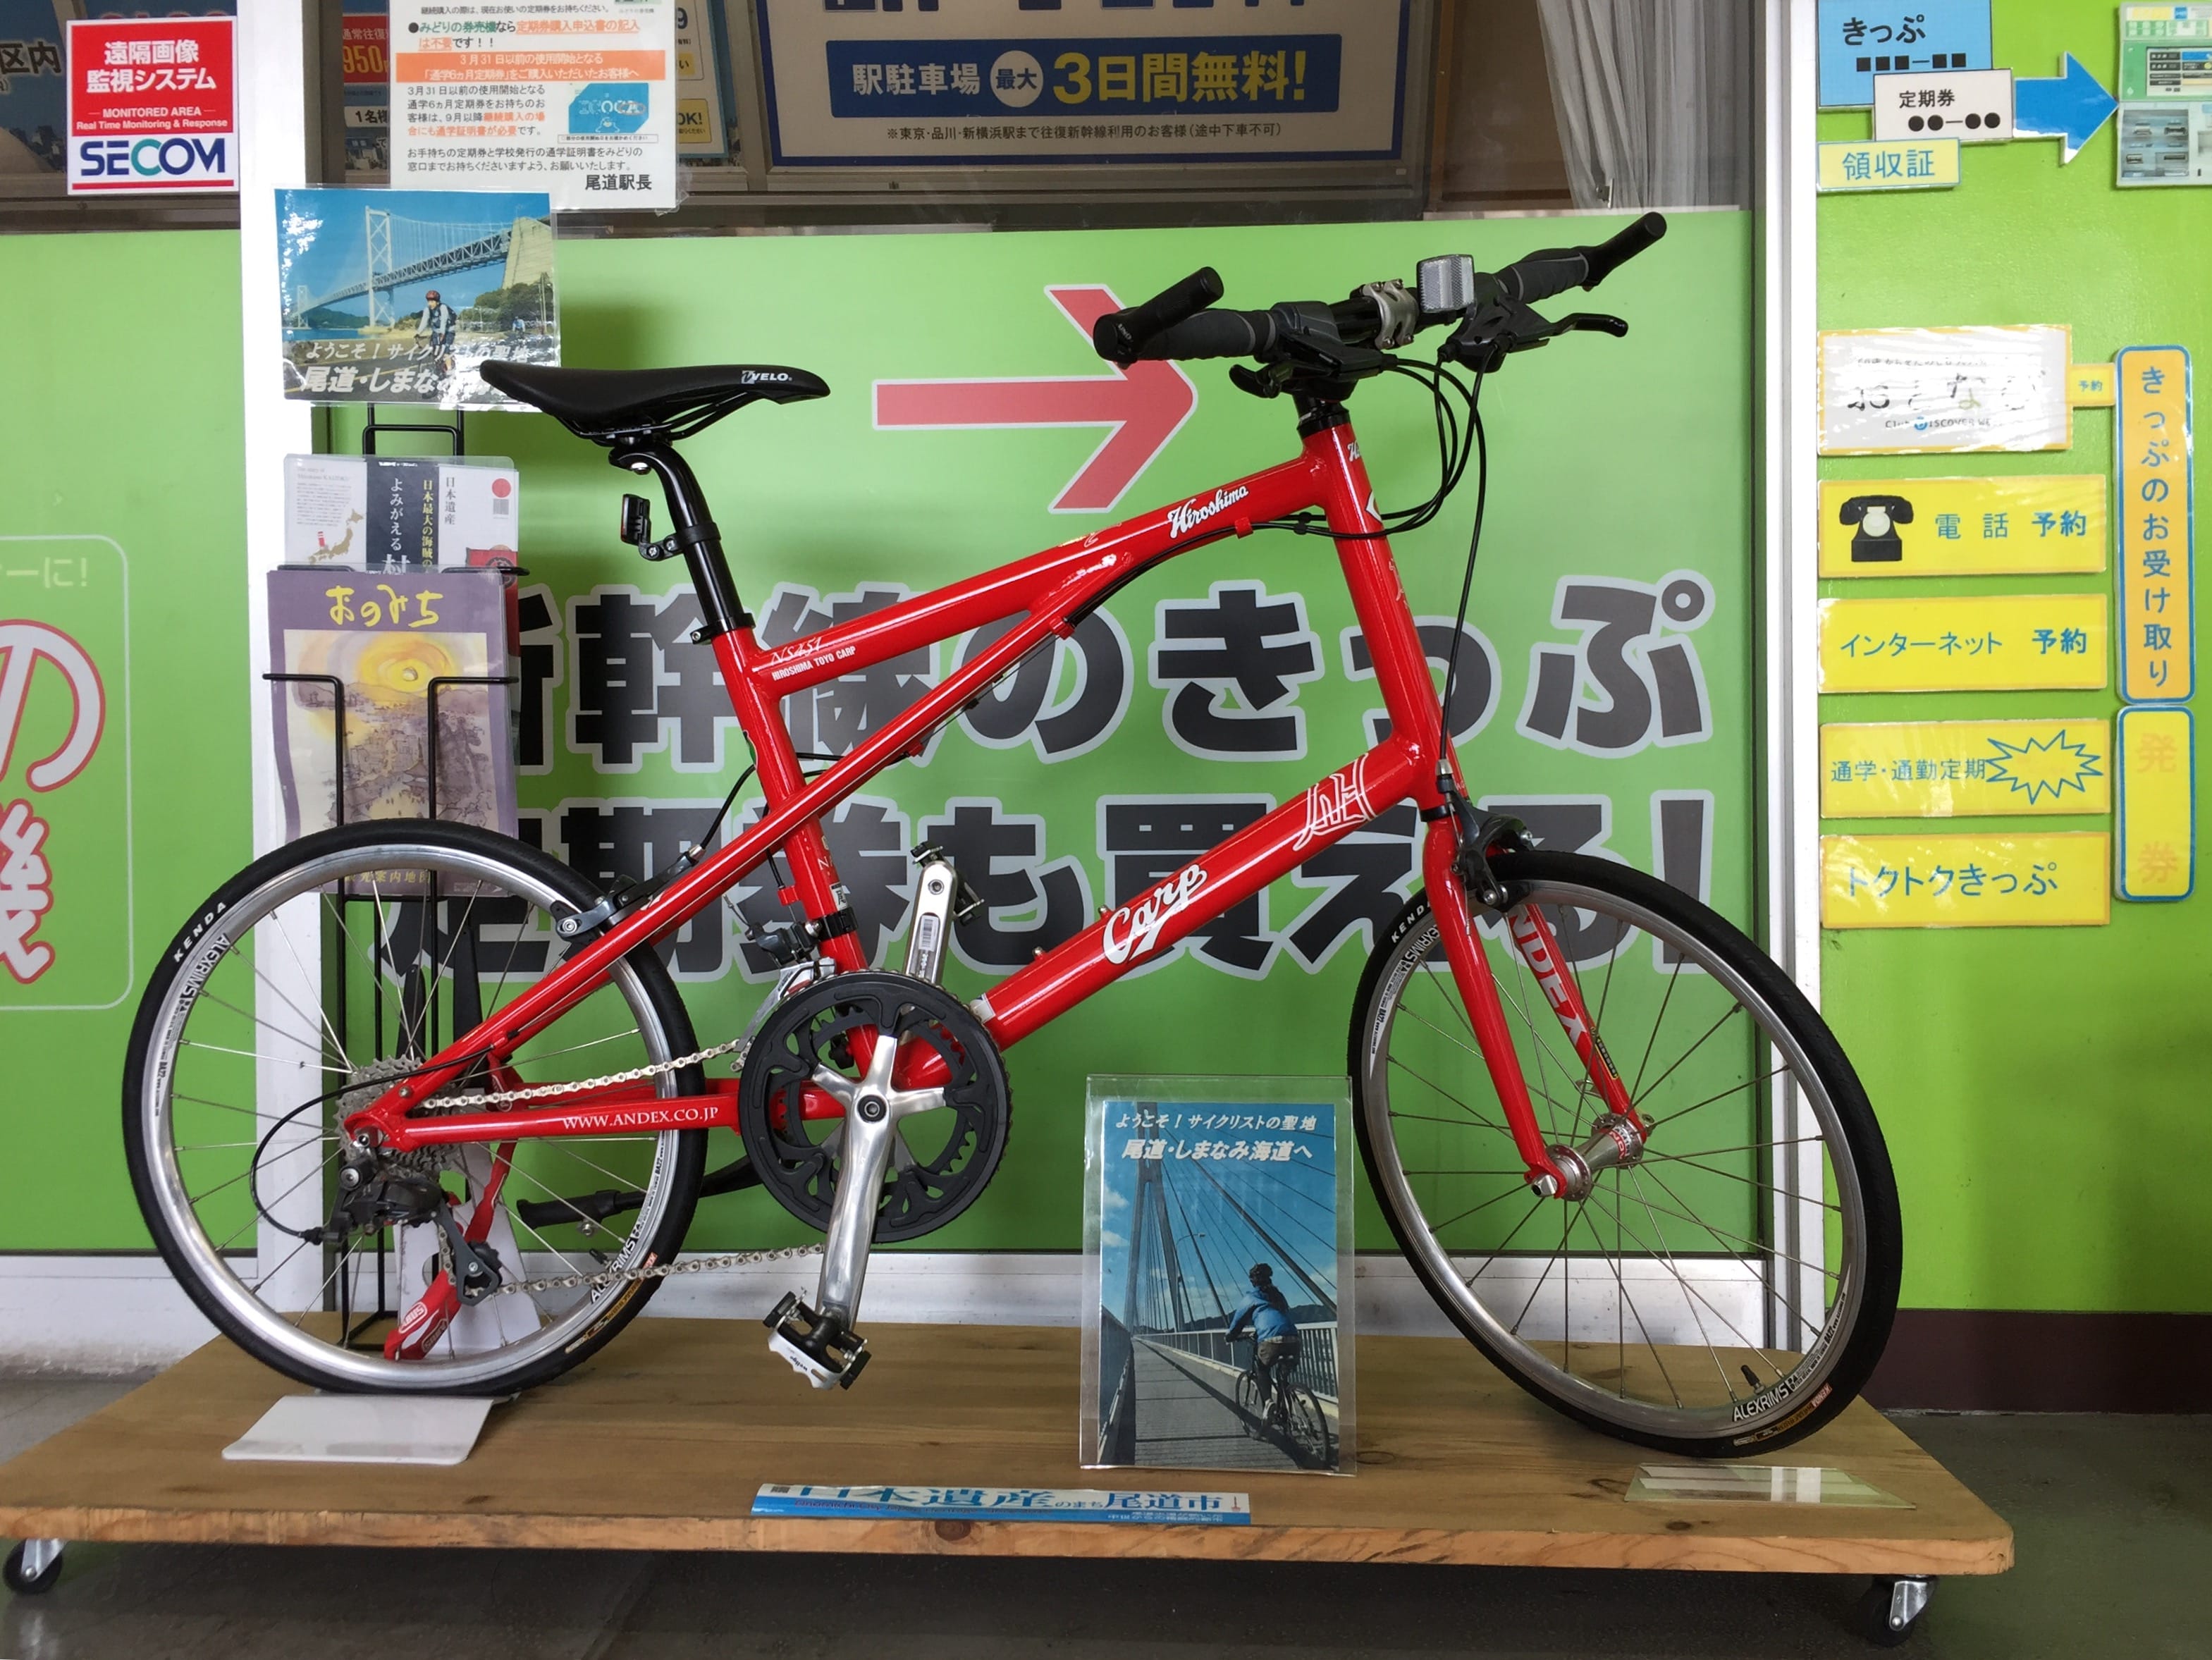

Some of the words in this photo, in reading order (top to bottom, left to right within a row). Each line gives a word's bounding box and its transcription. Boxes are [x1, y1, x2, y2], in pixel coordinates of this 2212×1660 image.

[1842, 14, 1926, 46] きっぷ
[104, 39, 199, 66] 遠隔画像
[86, 67, 217, 94] 監視システム
[852, 63, 981, 96] 駅駐車場
[995, 68, 1038, 91] 最大
[1052, 50, 1308, 105] 3日間無料!
[103, 107, 168, 118] MONITORED
[171, 106, 202, 116] AREA
[1898, 88, 1955, 109] 定期券
[76, 121, 97, 130] Real
[98, 121, 121, 130] Time
[123, 120, 171, 130] Monitoring
[173, 120, 180, 128] &
[182, 118, 228, 130] Response
[80, 137, 226, 177] SECOM
[1842, 149, 1935, 180] 領収証
[585, 174, 653, 191] 尾道駅長
[752, 372, 789, 382] VELO
[2078, 379, 2103, 392] 予約
[445, 477, 457, 525] 日本遺産
[1168, 485, 1249, 539] Hiroshima
[2140, 366, 2173, 687] きっぷのお受け取り
[325, 584, 444, 628] おのみち
[1840, 632, 2003, 657] インターネット
[2032, 627, 2088, 654] 予約
[770, 660, 814, 682] HIROSHIMA
[814, 653, 835, 667] TOYO
[836, 645, 856, 660] CARP
[1831, 757, 1987, 782] 通学・通勤定期
[1848, 862, 2058, 897] トクトクきっぷ
[1102, 863, 1208, 965] Carp
[1390, 902, 1432, 945] KEND
[173, 901, 227, 963] KENDA
[562, 1106, 719, 1130] WWW.ANDEX.CO.JP
[1122, 1138, 1314, 1162] 尾道・しまなみ海道へ
[1733, 1382, 1790, 1422] ALEXRIMS
